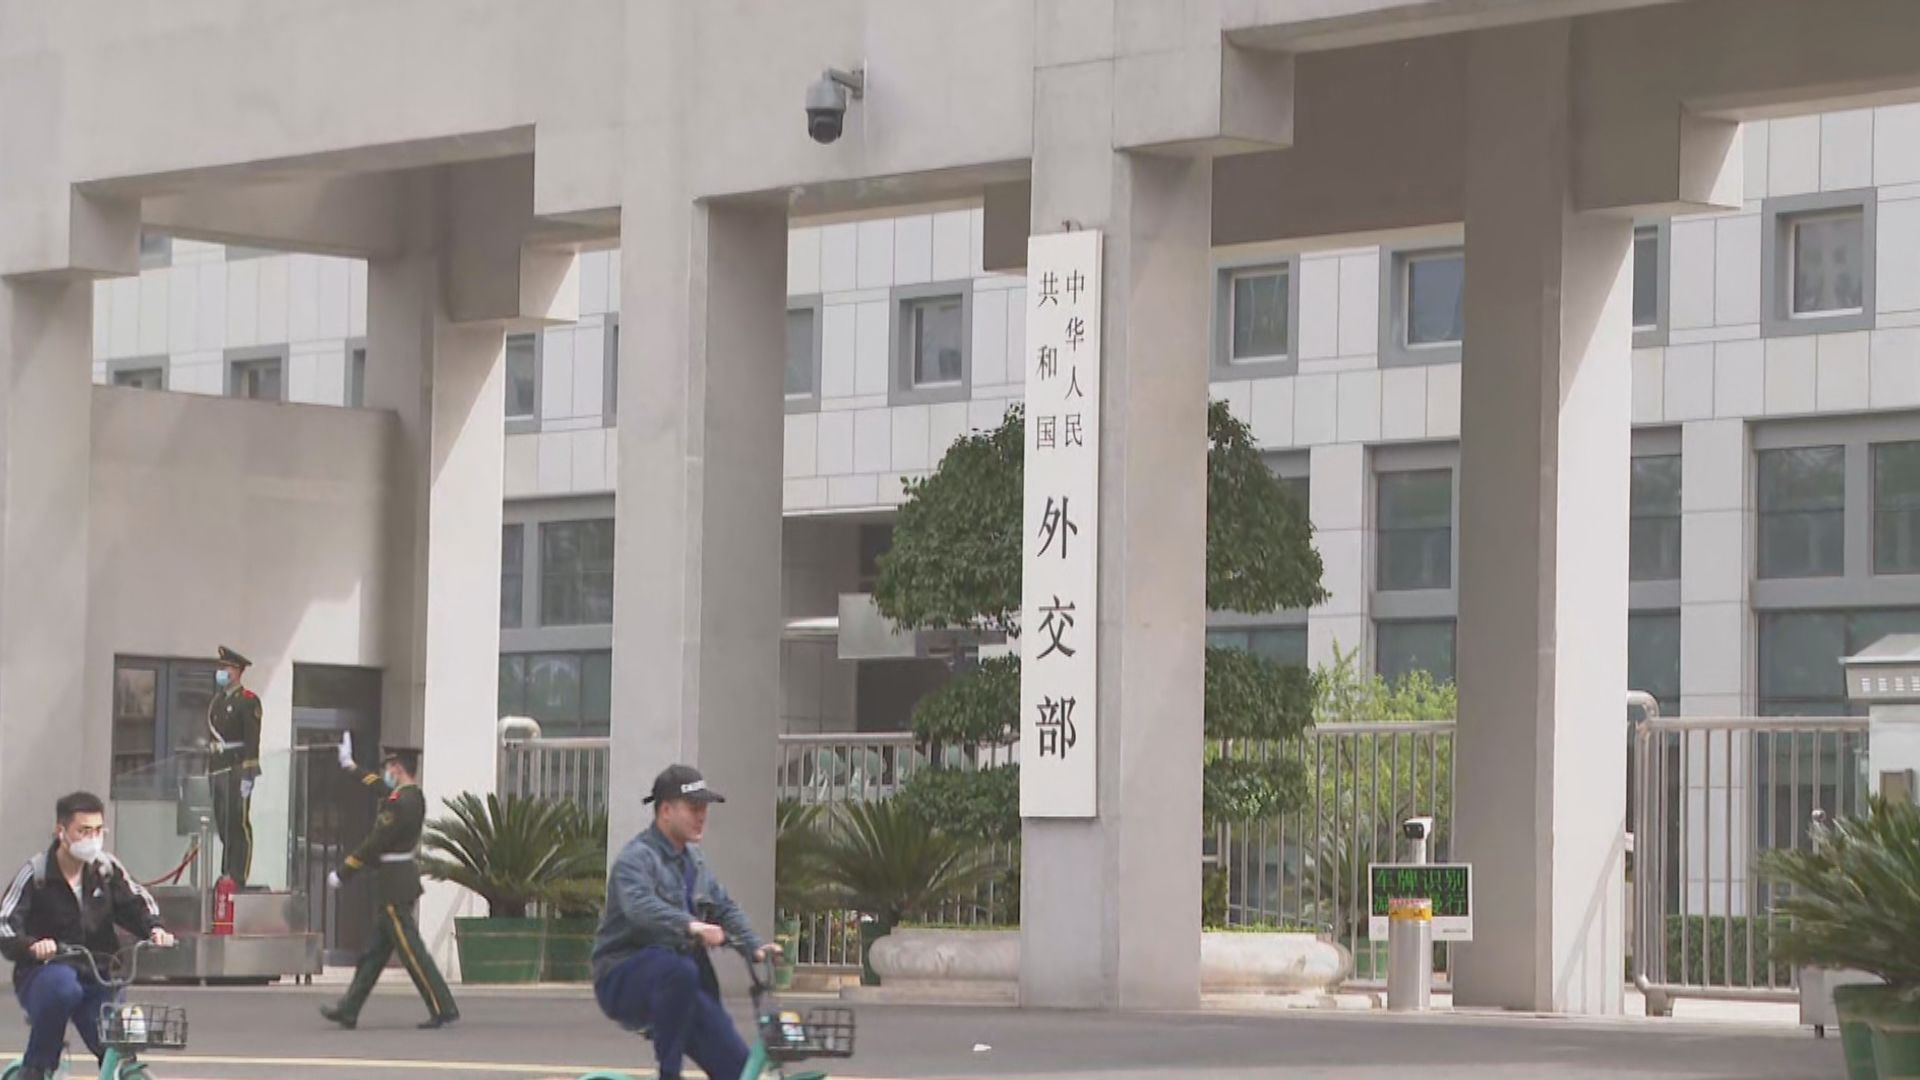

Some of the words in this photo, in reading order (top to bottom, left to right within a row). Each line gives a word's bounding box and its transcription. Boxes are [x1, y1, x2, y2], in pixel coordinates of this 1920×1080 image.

[1036, 271, 1059, 451] 共和国
[1064, 268, 1085, 447] 中华人民
[1035, 495, 1078, 760] 外交部
